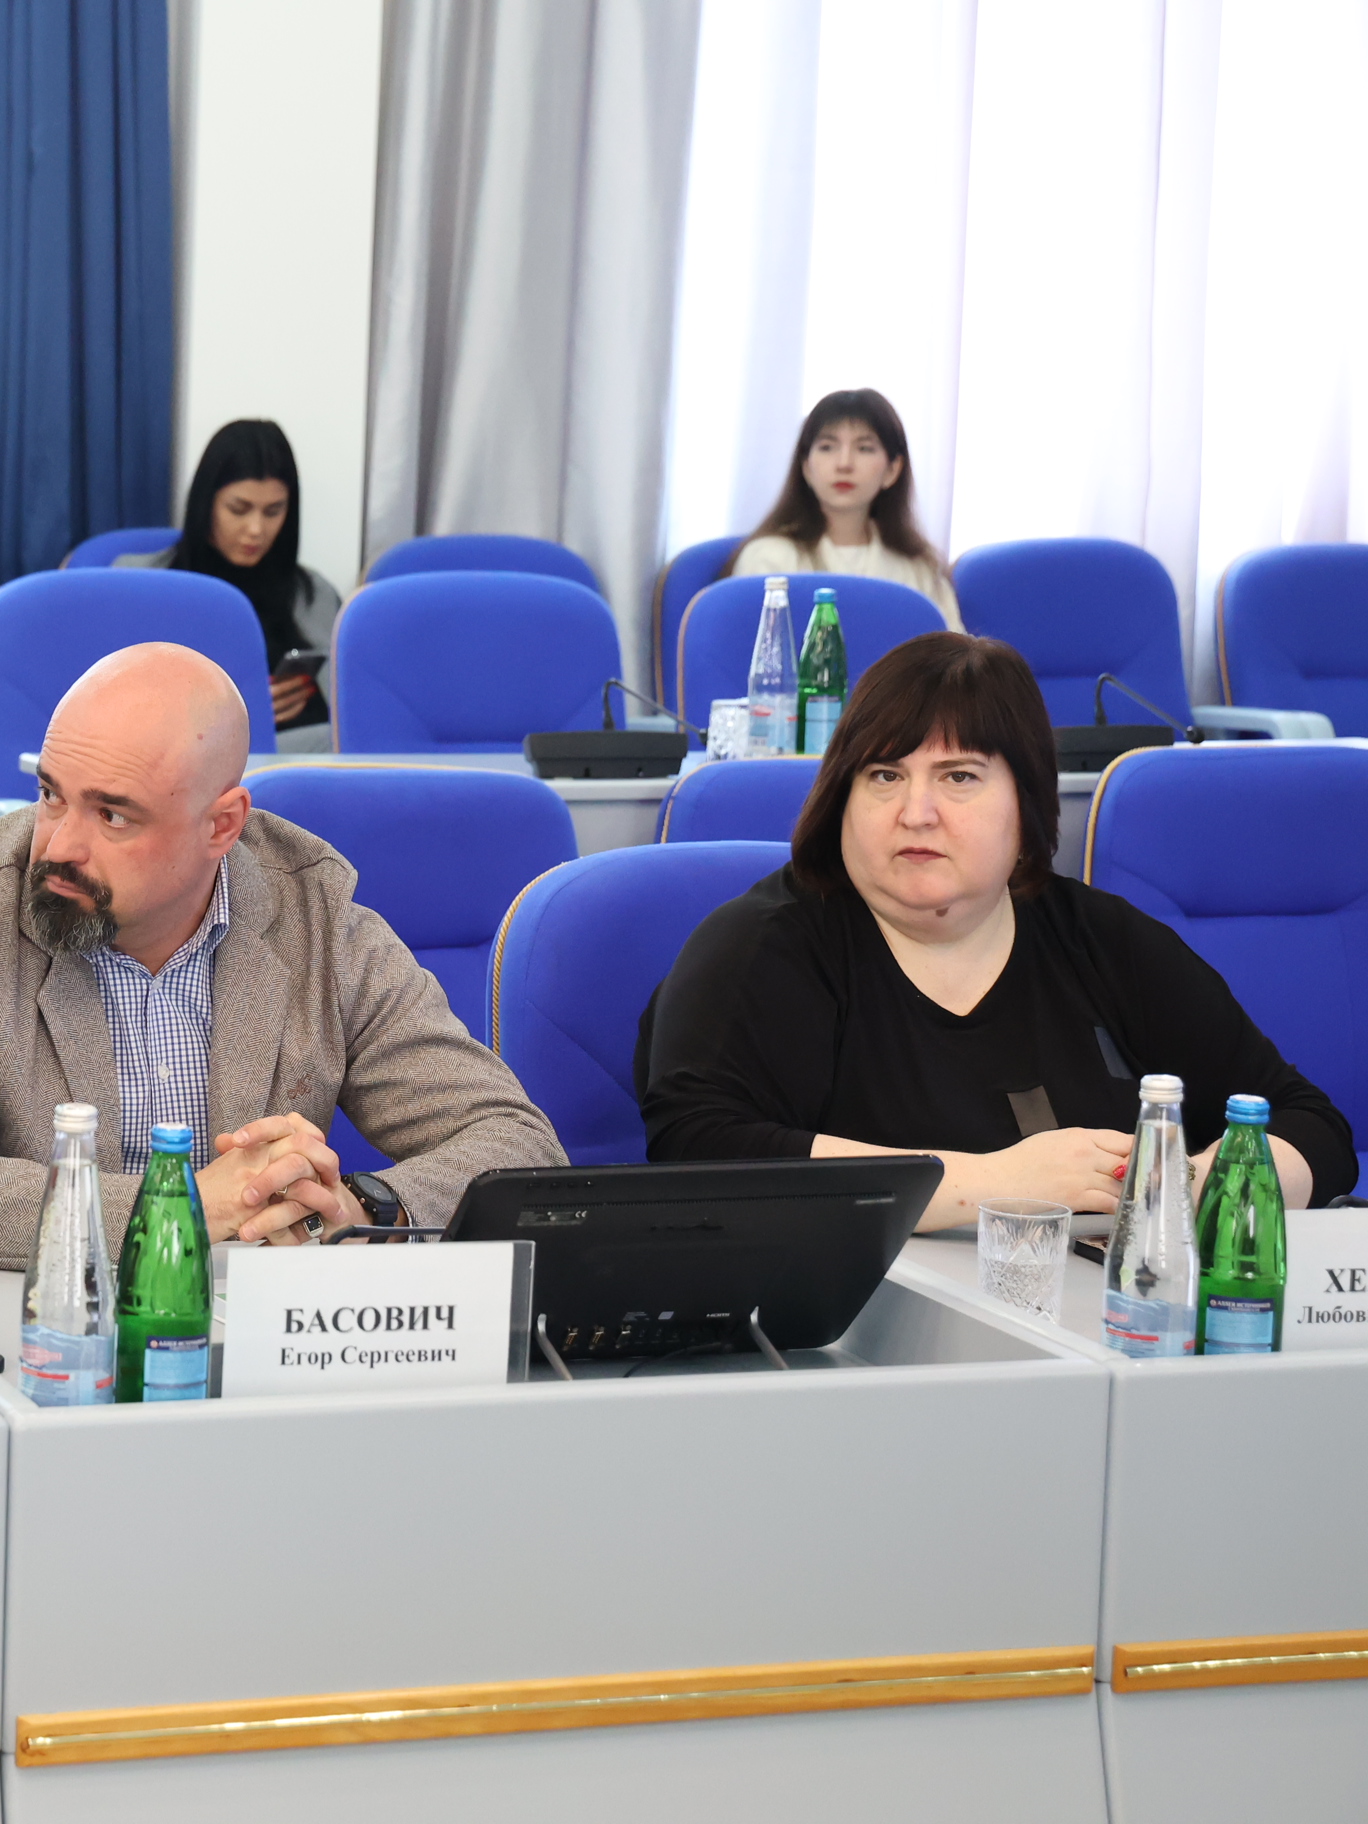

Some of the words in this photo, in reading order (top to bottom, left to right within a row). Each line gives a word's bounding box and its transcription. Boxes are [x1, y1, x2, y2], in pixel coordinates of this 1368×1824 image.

[1324, 1268, 1367, 1293] ХЕ
[284, 1305, 456, 1334] БАСОВИЧ
[1296, 1305, 1367, 1324] Любов
[280, 1347, 333, 1370] Егор
[340, 1346, 456, 1369] Сергеевич
